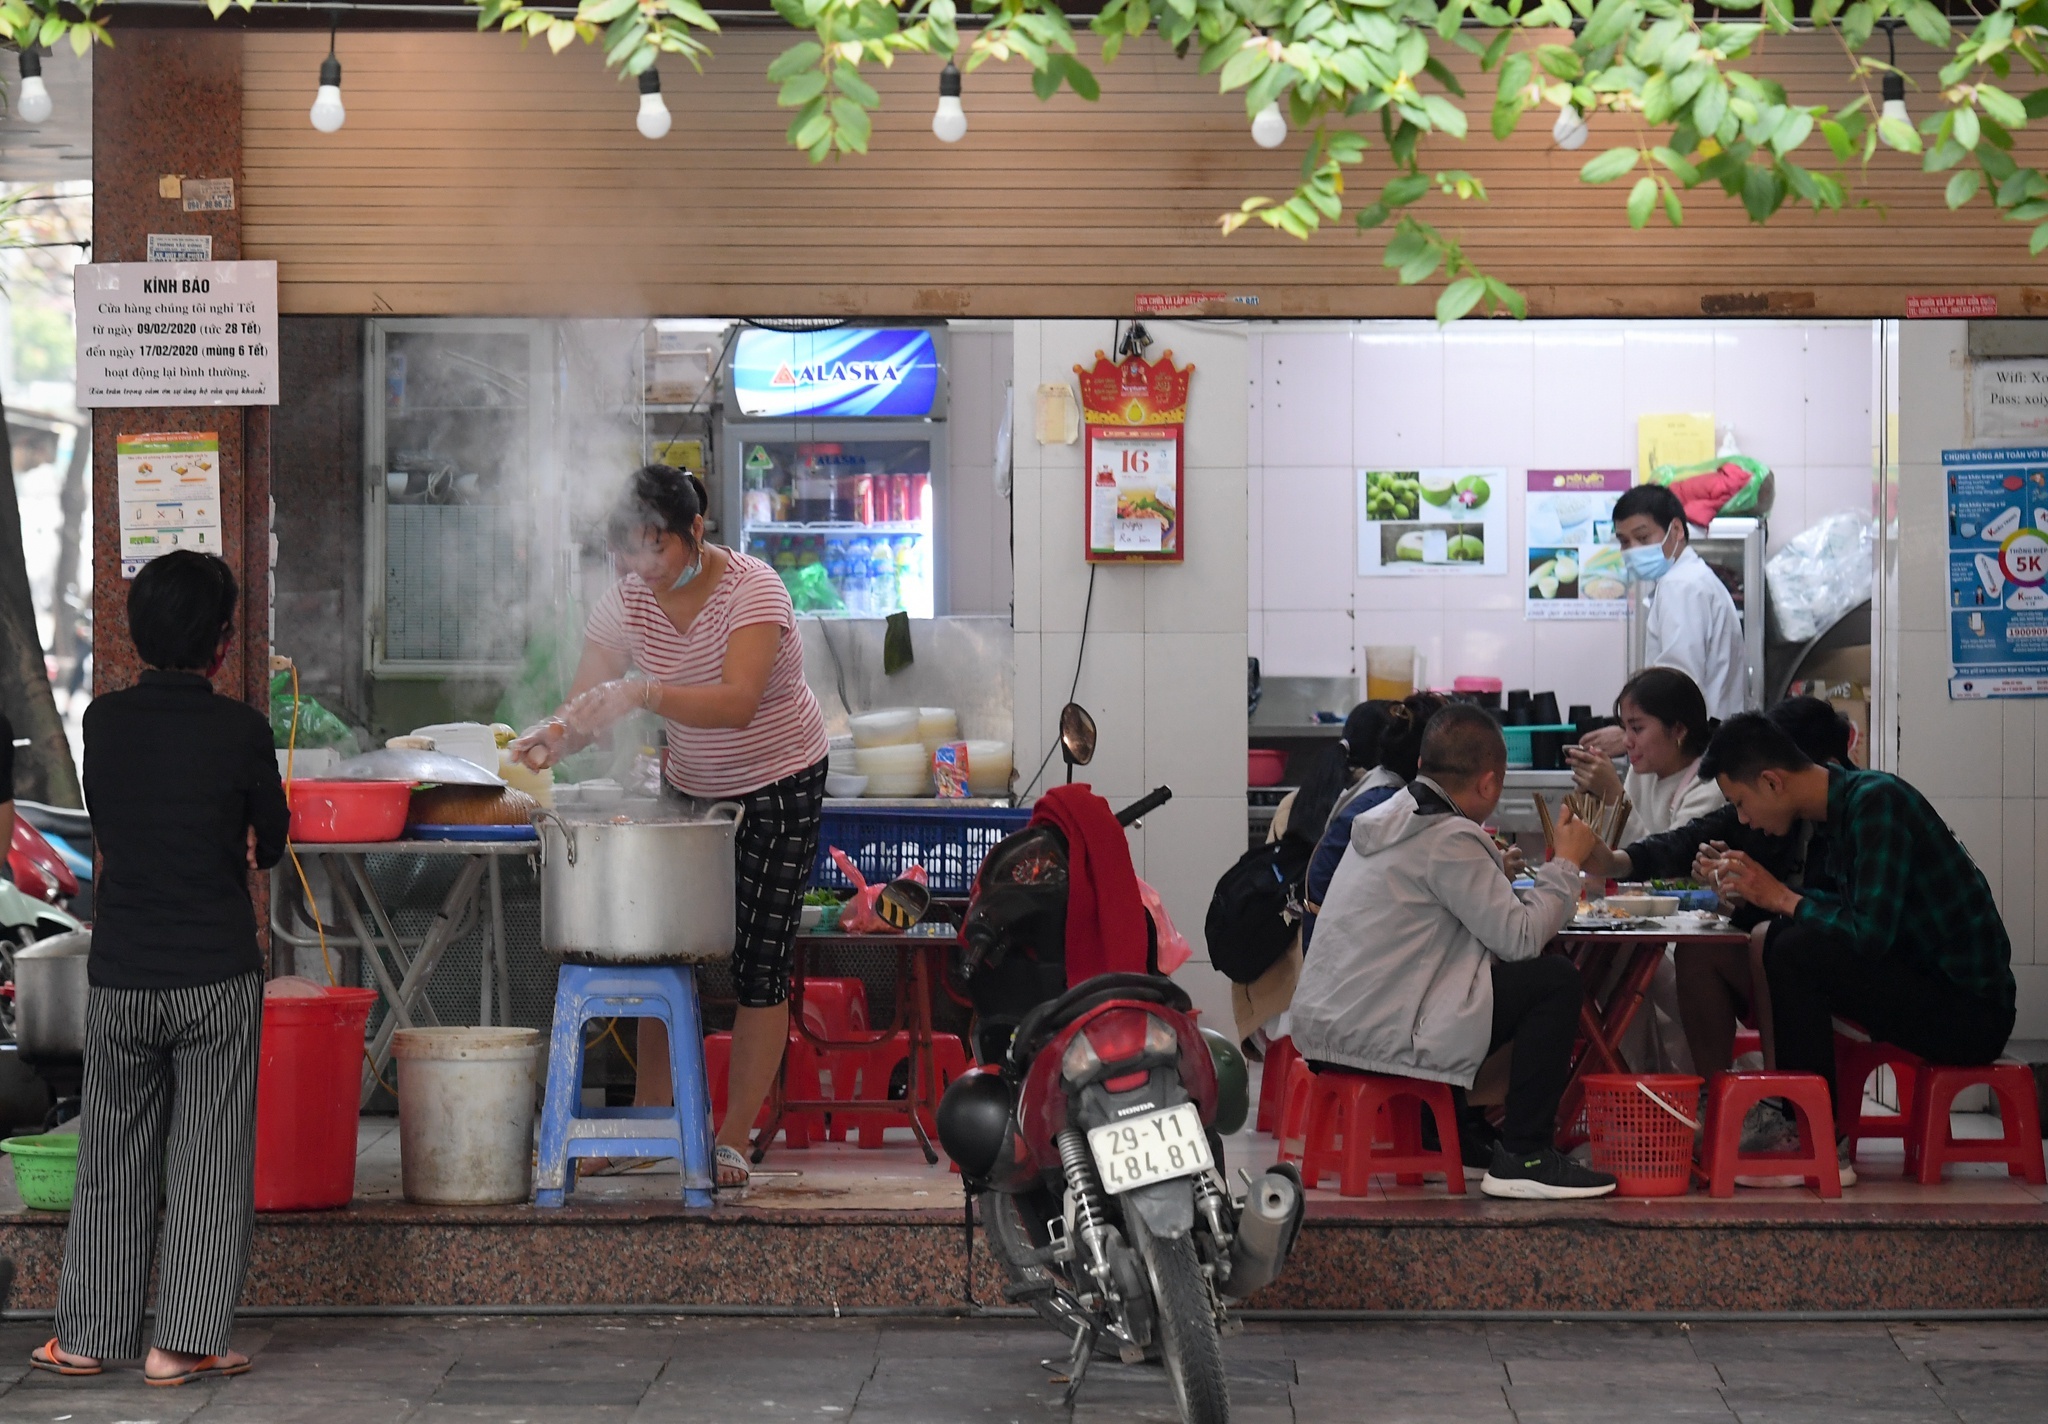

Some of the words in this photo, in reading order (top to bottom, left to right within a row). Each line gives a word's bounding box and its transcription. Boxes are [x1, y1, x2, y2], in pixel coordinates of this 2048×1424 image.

[144, 276, 178, 294] KÍNH
[182, 276, 210, 294] BÁO
[98, 302, 120, 314] Cửa
[124, 303, 152, 315] hàng
[155, 303, 188, 315] chúng
[192, 303, 206, 313] tôi
[210, 303, 234, 315] nghỉ
[237, 301, 255, 313] Tết
[93, 324, 104, 334] từ
[108, 324, 133, 336] ngày
[137, 323, 196, 334] 09/02/2020
[200, 324, 221, 335] (tức
[225, 323, 238, 334] 28
[241, 320, 261, 335] Tết)
[86, 344, 106, 356] đến
[110, 346, 135, 358] ngày
[140, 345, 198, 356] 17/02/2020
[202, 344, 234, 358] (mùng
[238, 345, 244, 356] 6
[248, 343, 268, 356] Tết)
[104, 367, 128, 380] hoạt
[132, 367, 160, 380] động
[163, 367, 176, 380] lại
[180, 366, 204, 376] bình
[208, 366, 250, 378] thường.
[800, 364, 898, 381] ALASKA
[1996, 372, 2027, 383] Wifi:
[1122, 384, 1148, 392] Neptune
[1991, 392, 2020, 404] Pass:
[818, 455, 866, 465] ALASKA
[1122, 450, 1149, 473] 16
[1972, 452, 1992, 460] SỐNG
[1994, 452, 2004, 460] AN
[2006, 450, 2026, 459] TOÀN
[2010, 546, 2032, 554] THÔNG
[2016, 556, 2042, 572] 5K
[1118, 1102, 1155, 1116] HONDA
[1106, 1114, 1182, 1155] 29-Y1
[1109, 1140, 1201, 1184] 484.81
